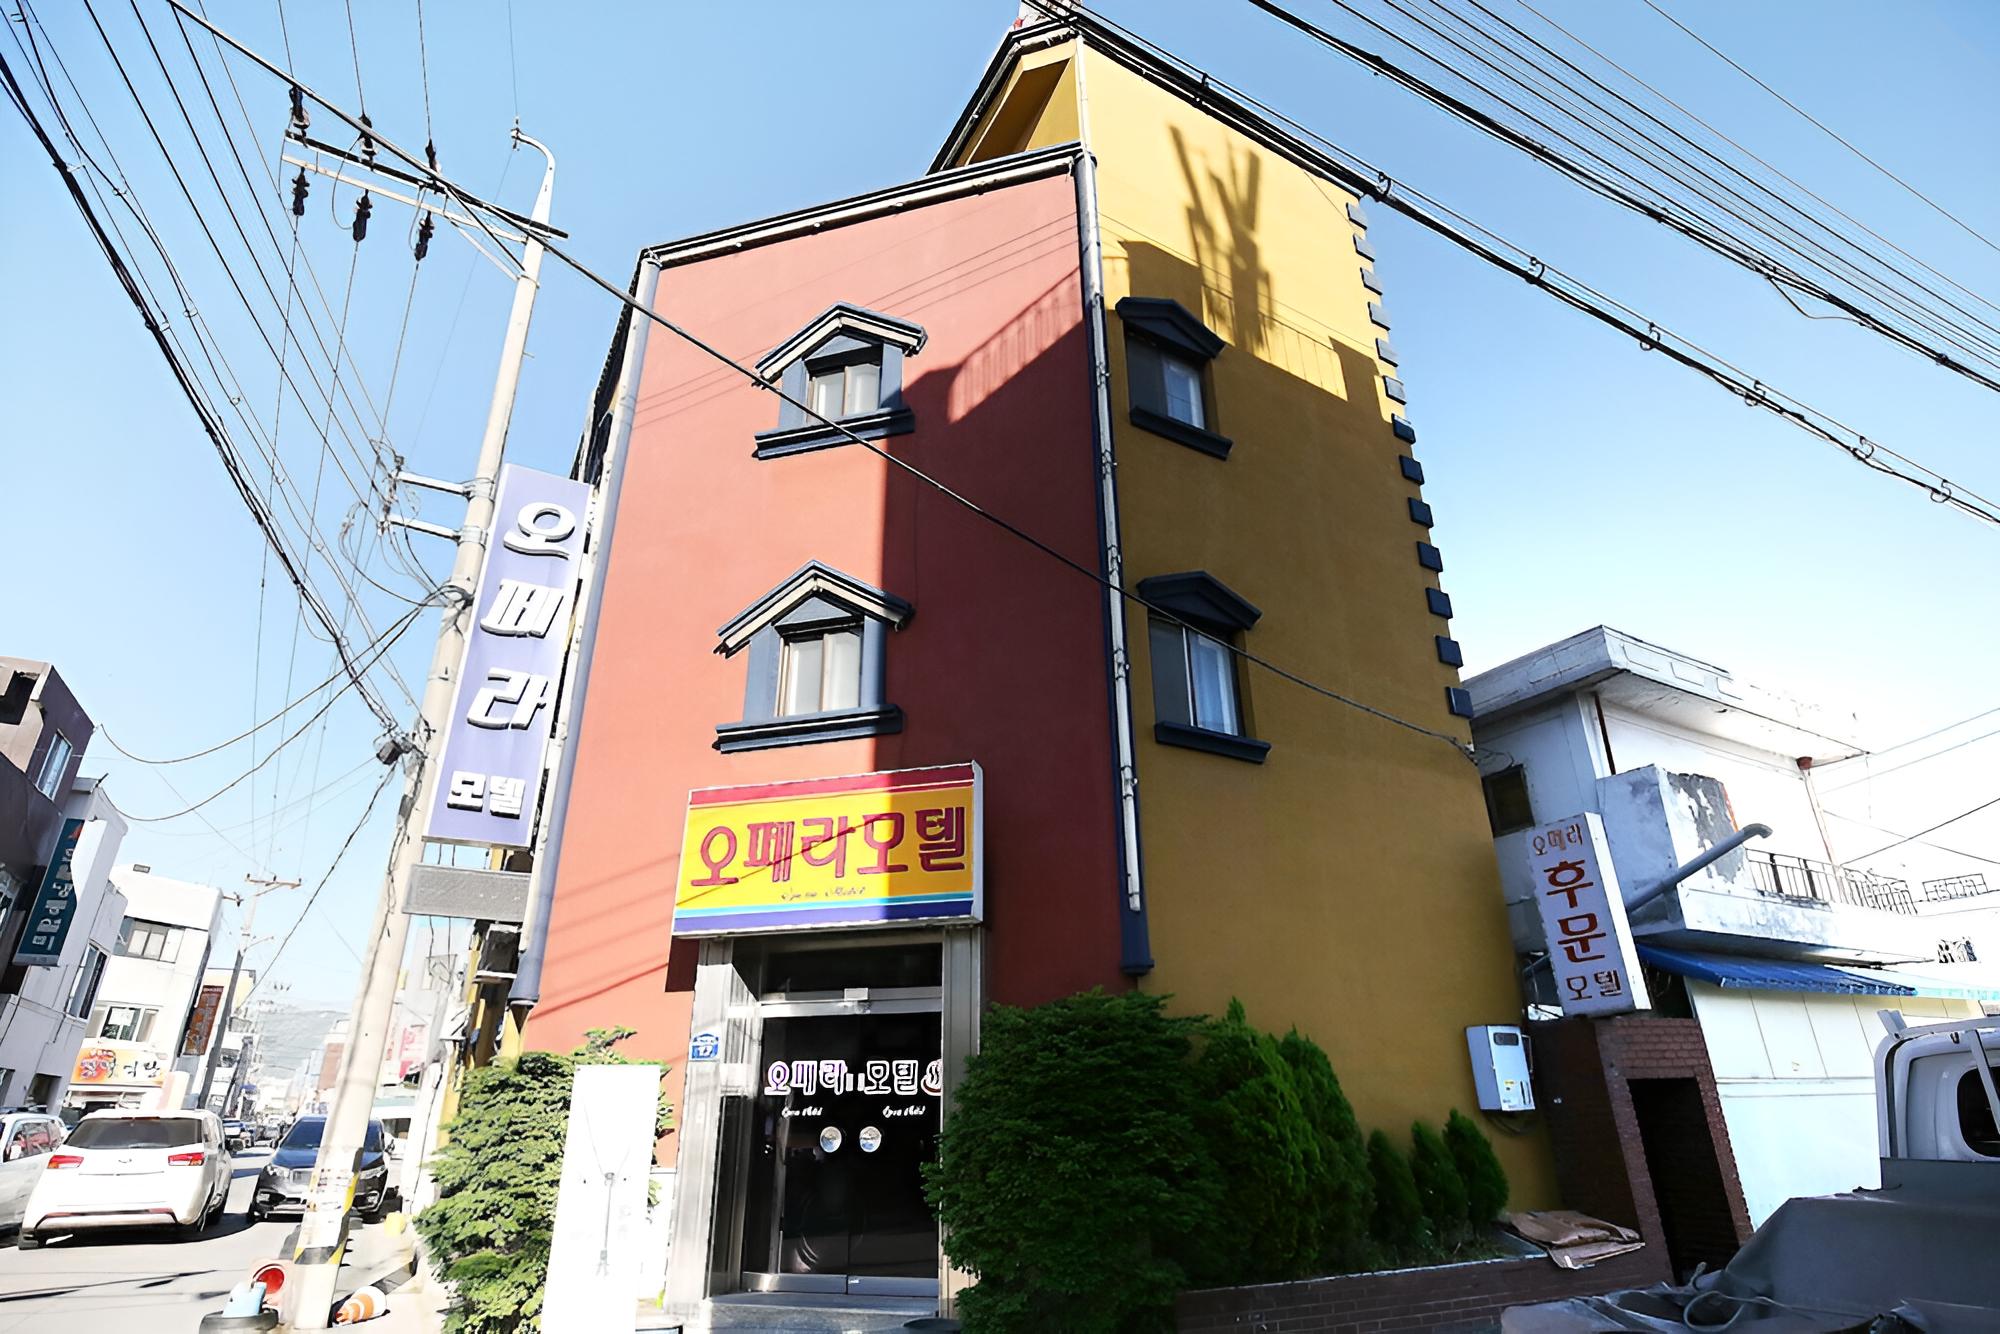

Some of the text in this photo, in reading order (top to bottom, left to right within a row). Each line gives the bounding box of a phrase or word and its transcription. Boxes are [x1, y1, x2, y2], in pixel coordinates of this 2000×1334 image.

[467, 501, 576, 730] 오페라
[447, 770, 525, 819] 모텔
[1543, 859, 1607, 963] 후문
[1566, 969, 1622, 1001] 모텔
